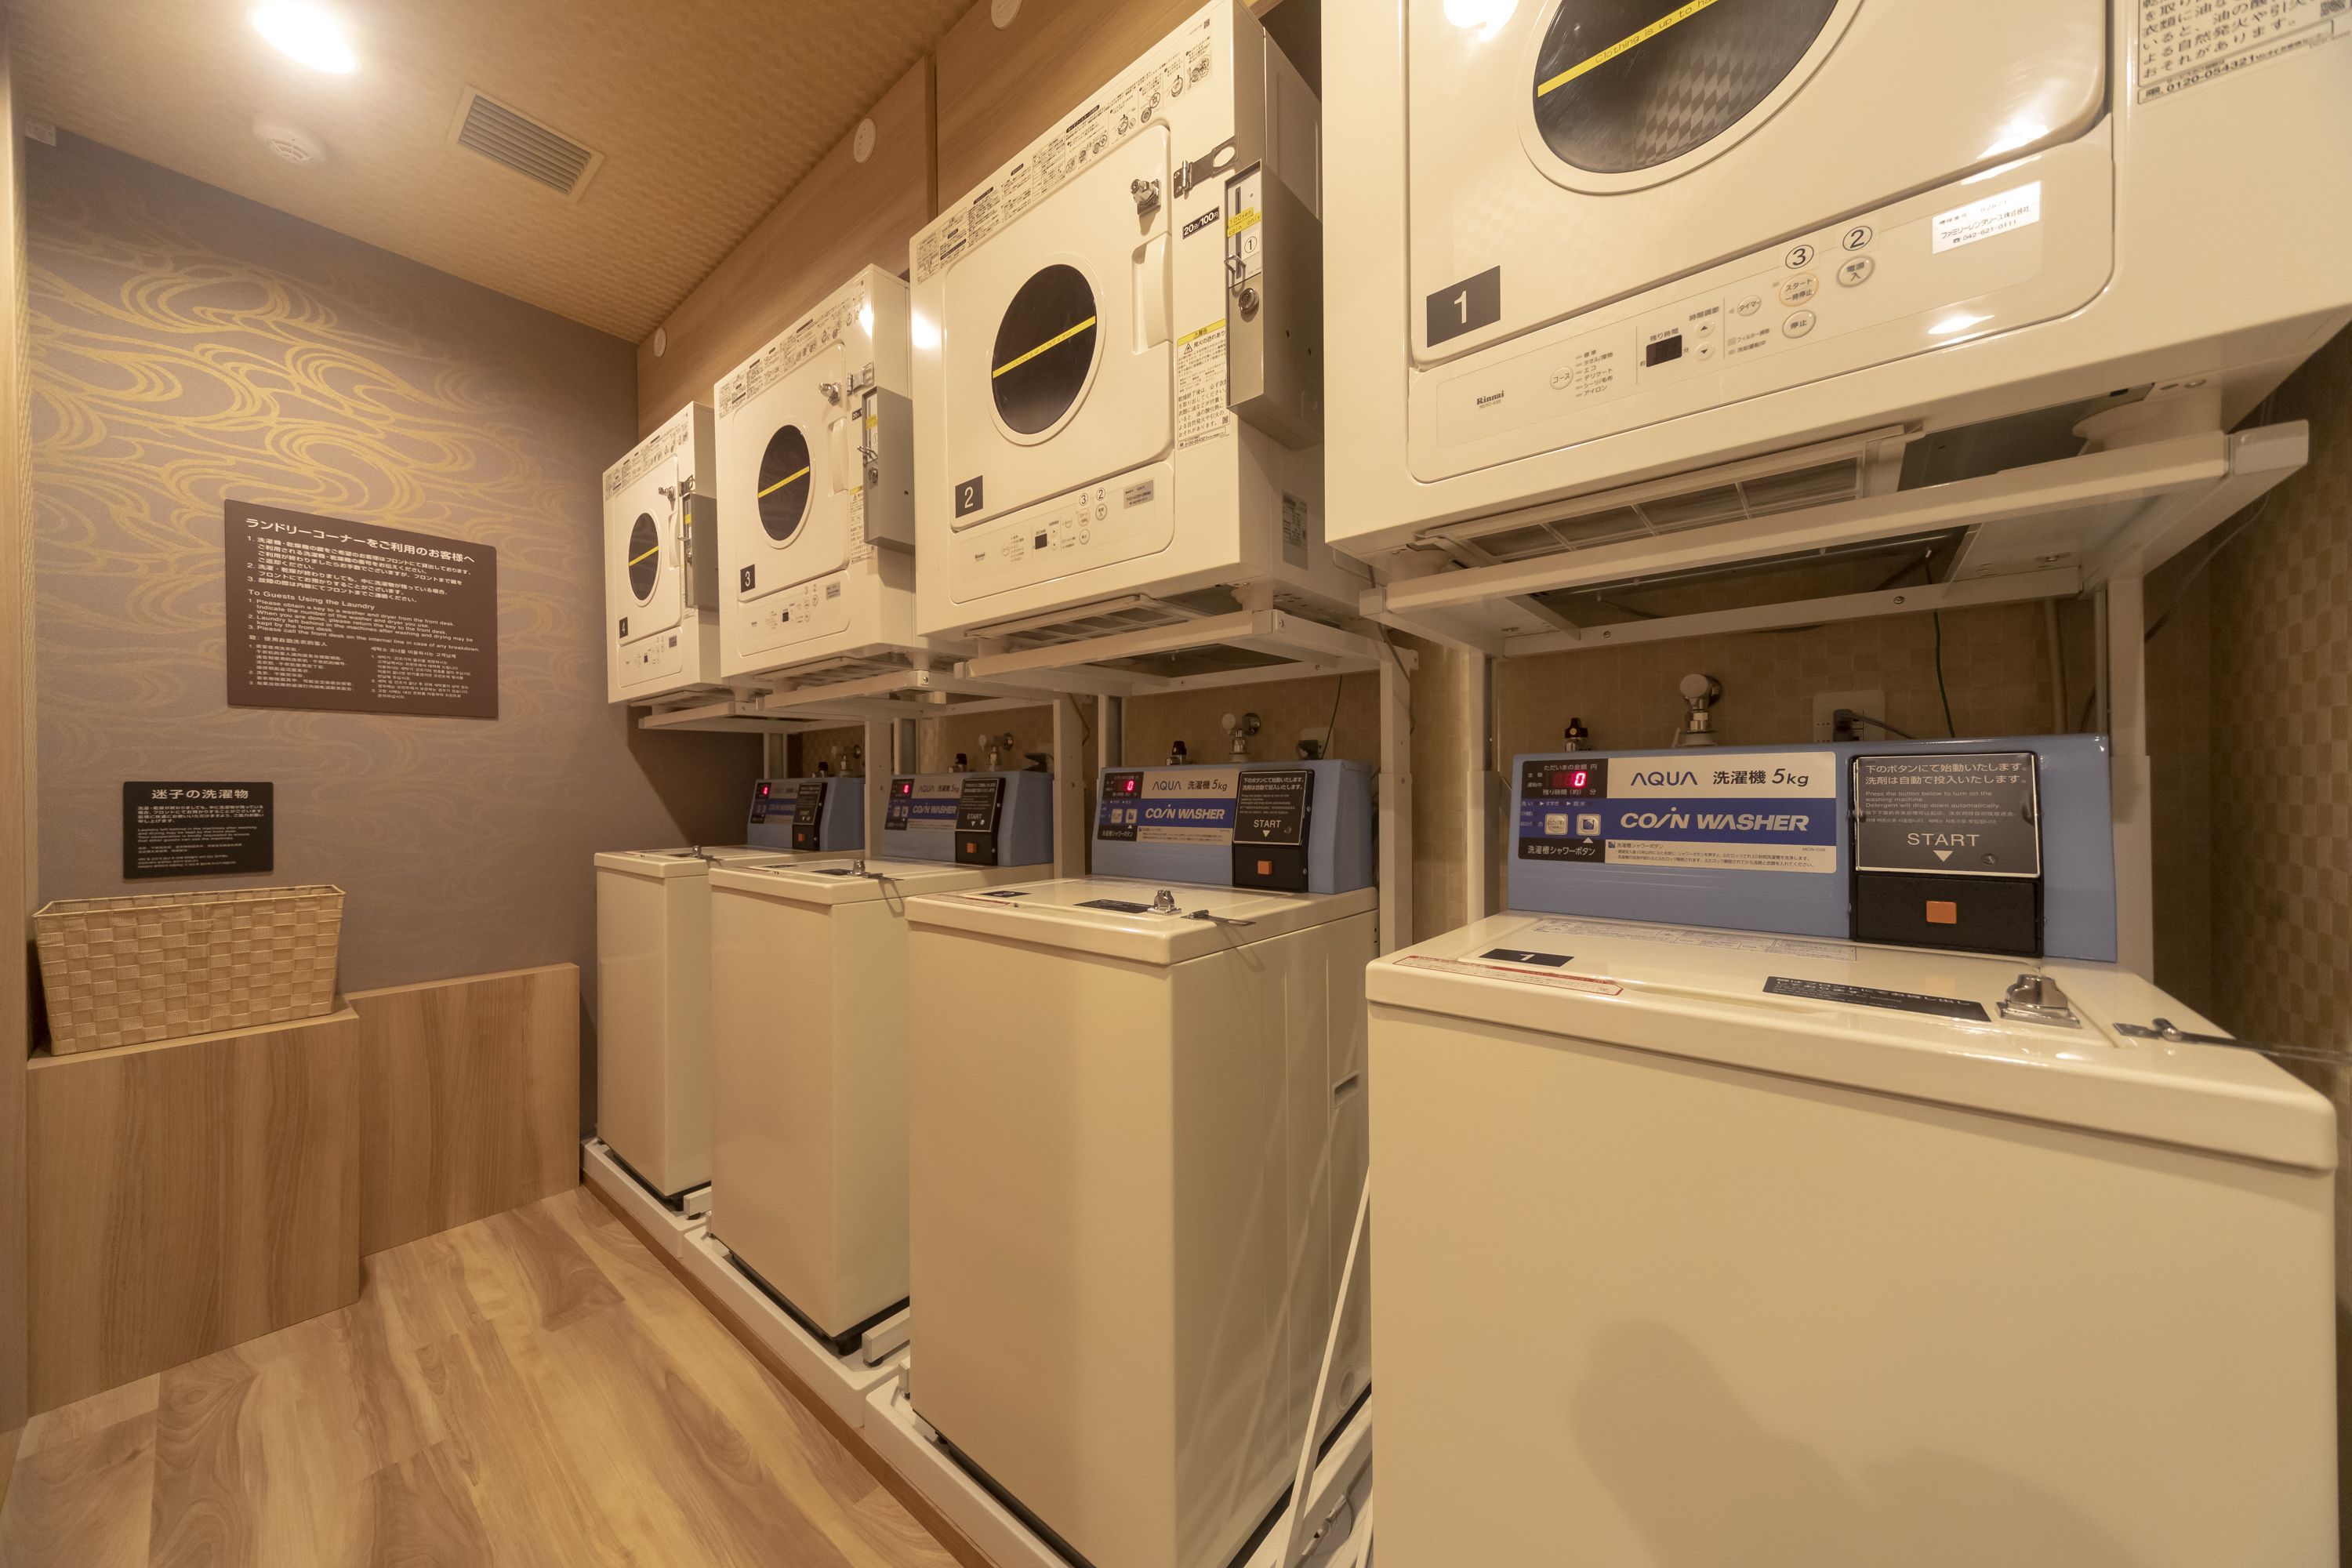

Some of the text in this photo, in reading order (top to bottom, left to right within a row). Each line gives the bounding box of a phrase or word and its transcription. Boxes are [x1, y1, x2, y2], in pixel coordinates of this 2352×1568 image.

[1595, 7, 1692, 64] Clothing is up to
[1846, 262, 1864, 273] 電源
[1785, 278, 1813, 292] スタート
[1785, 290, 1813, 301] 一時停止
[1454, 290, 1468, 324] 1
[1738, 301, 1760, 312] タイマー
[1790, 319, 1807, 329] 停止
[1552, 372, 1570, 384] コース
[1583, 368, 1613, 381] デリケート
[1476, 390, 1504, 405] Rinnai
[1583, 385, 1608, 397] アイロン
[964, 486, 974, 509] 2
[245, 517, 475, 563] ランドリーコーナーをご利用のお客様へ
[745, 571, 751, 586] 3
[263, 591, 296, 601] Guests
[298, 596, 323, 604] Using
[342, 601, 375, 610] Laundry
[1865, 763, 2027, 773] 下のボタンにて始動いたします。
[1574, 772, 1587, 786] 0
[1631, 768, 1809, 787] AQUA 洗濯機 5kg
[1865, 775, 2027, 785] 洗剤は自動で投入いたします。
[1127, 780, 1134, 791] 0
[1152, 779, 1228, 792] AQUA 洗濯機 5kg
[152, 789, 249, 800] 迷子の洗濯物
[1178, 808, 1225, 820] WASHER
[1697, 814, 1809, 831] WASHER
[1907, 833, 1980, 847] START
[1527, 845, 1595, 855] 洗濯槽シャワーボタン
